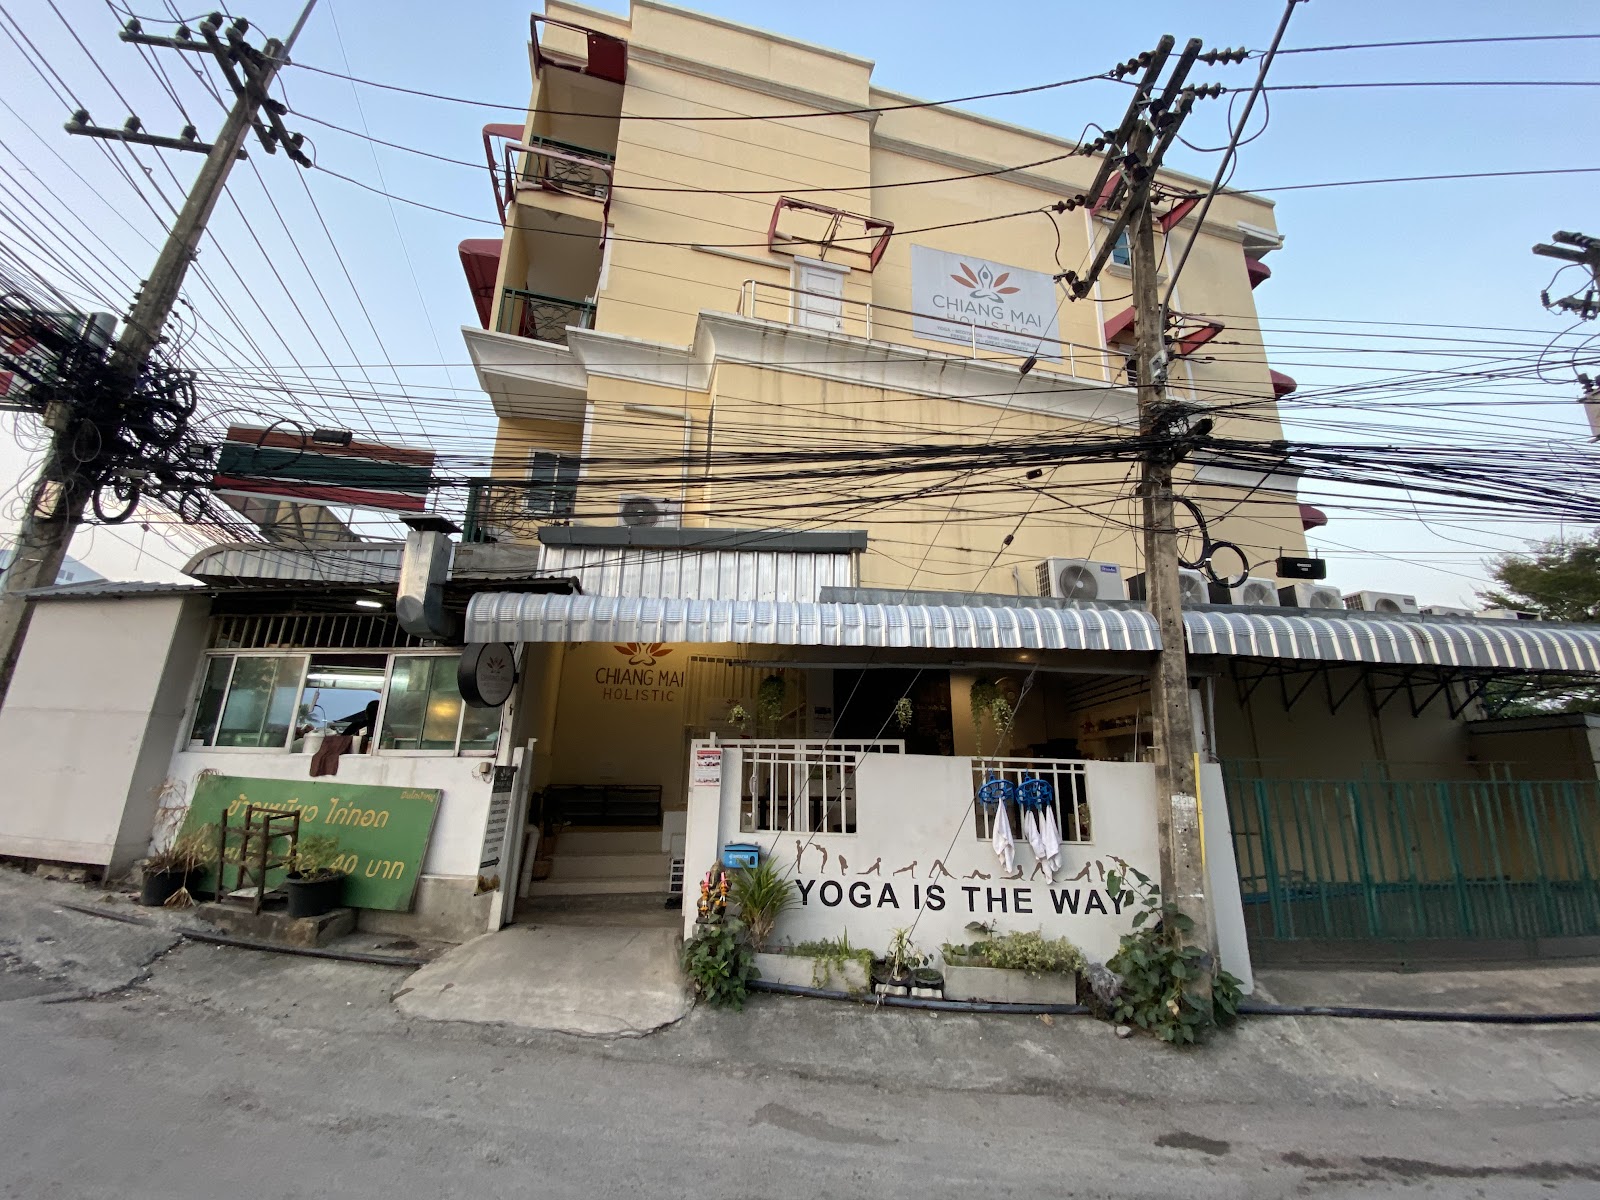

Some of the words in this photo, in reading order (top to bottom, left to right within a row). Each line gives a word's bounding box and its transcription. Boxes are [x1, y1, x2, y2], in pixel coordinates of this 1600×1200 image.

[932, 294, 1004, 320] CHIANG
[1010, 309, 1042, 328] MAI
[595, 667, 654, 686] CHIANG
[658, 669, 685, 688] MAI
[602, 687, 675, 702] HOLISTIC
[325, 797, 390, 828] ไก่ทอด
[365, 859, 405, 880] บาท
[795, 879, 900, 910] YOGA
[913, 884, 946, 912] IS
[961, 886, 1033, 914] THE
[1049, 888, 1127, 916] WAY
